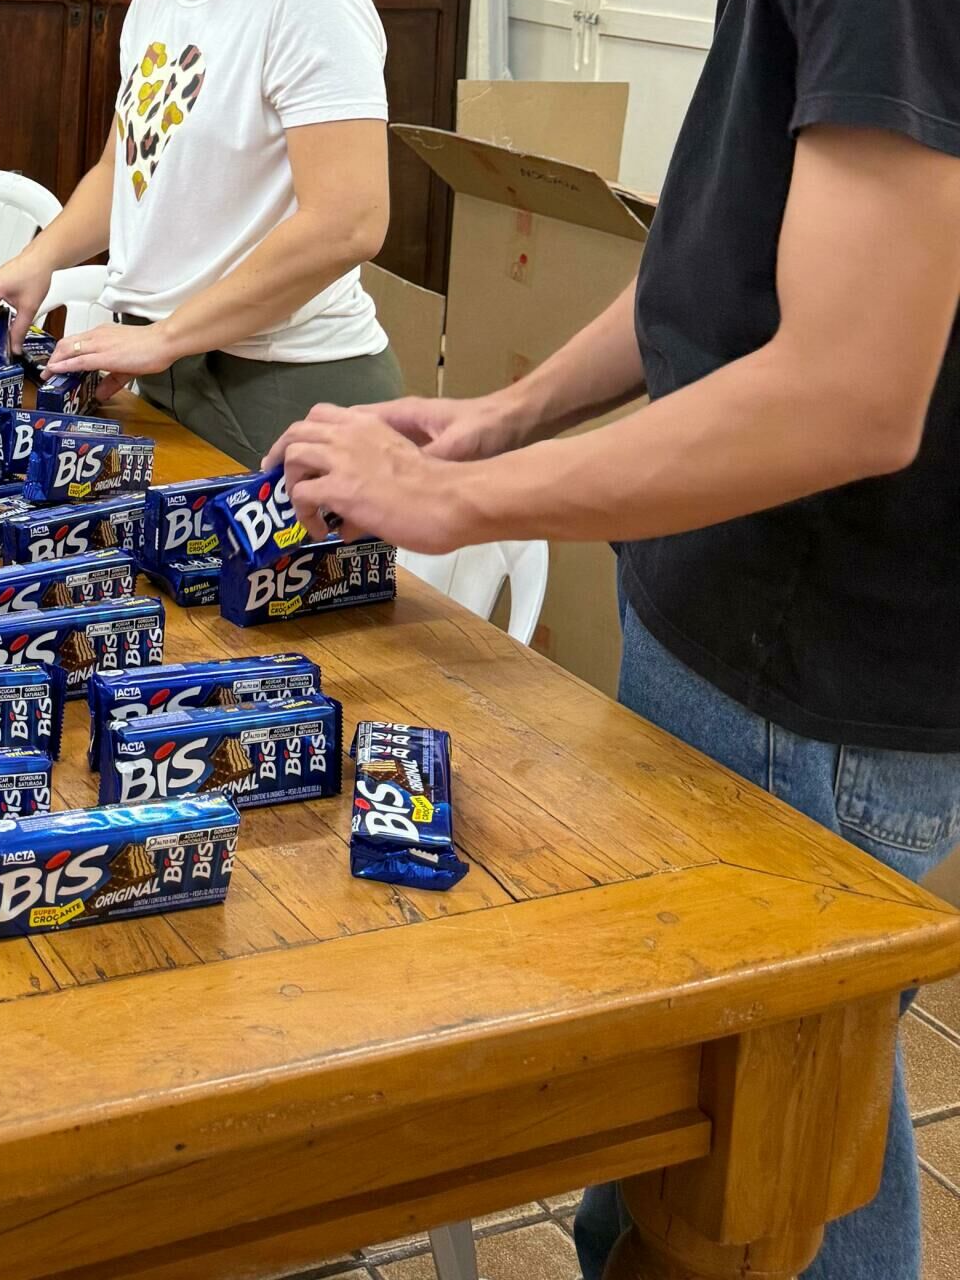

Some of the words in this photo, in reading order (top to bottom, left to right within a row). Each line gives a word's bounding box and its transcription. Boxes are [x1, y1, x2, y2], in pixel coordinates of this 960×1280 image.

[53, 443, 105, 488] BiS
[94, 476, 122, 491] ORIGINAL
[168, 495, 187, 506] LACTA
[28, 520, 90, 562] BiS
[30, 526, 49, 537] LACTA
[189, 534, 217, 553] CROCANTE
[245, 553, 314, 611] BiS
[308, 581, 349, 604] ORIGINAL
[271, 598, 301, 614] CROCANTE
[115, 687, 141, 700] LACTA
[10, 699, 29, 740] BiS
[117, 741, 146, 756] LACTA
[115, 737, 209, 803] BiS
[401, 759, 424, 792] ORIGINAL
[357, 780, 419, 842] BiS
[2, 851, 36, 865] LACTA
[163, 847, 185, 884] BiS
[95, 877, 161, 909] ORIGINAL
[33, 908, 57, 916] SUPER
[33, 901, 81, 924] CROCANTE
